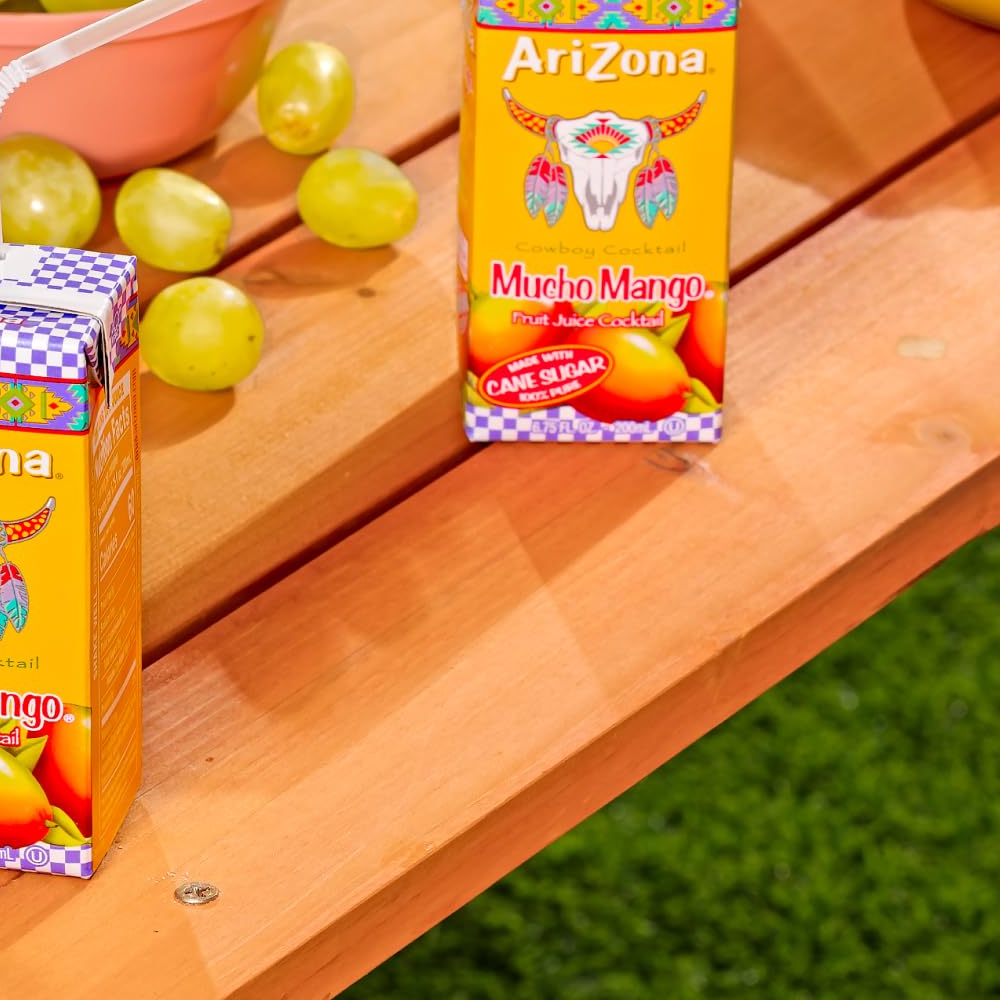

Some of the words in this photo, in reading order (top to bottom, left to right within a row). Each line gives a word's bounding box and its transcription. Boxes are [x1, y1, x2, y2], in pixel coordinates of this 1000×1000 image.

[501, 35, 706, 82] AriZona
[515, 242, 596, 258] Cowboy
[603, 242, 686, 256] Cocktail
[490, 260, 594, 302] Mucho
[598, 264, 706, 311] Mango
[512, 311, 549, 326] Fruit
[552, 312, 594, 327] Juice
[598, 310, 665, 329] Cocktail
[507, 357, 540, 373] MADE
[541, 350, 574, 361] WITH
[486, 371, 538, 397] CANE
[539, 355, 606, 384] SUGAR
[519, 391, 550, 402] 100%
[551, 380, 582, 398] PURE
[111, 406, 130, 444] Facts
[530, 420, 558, 433] 6.75
[614, 420, 651, 434] 200mL
